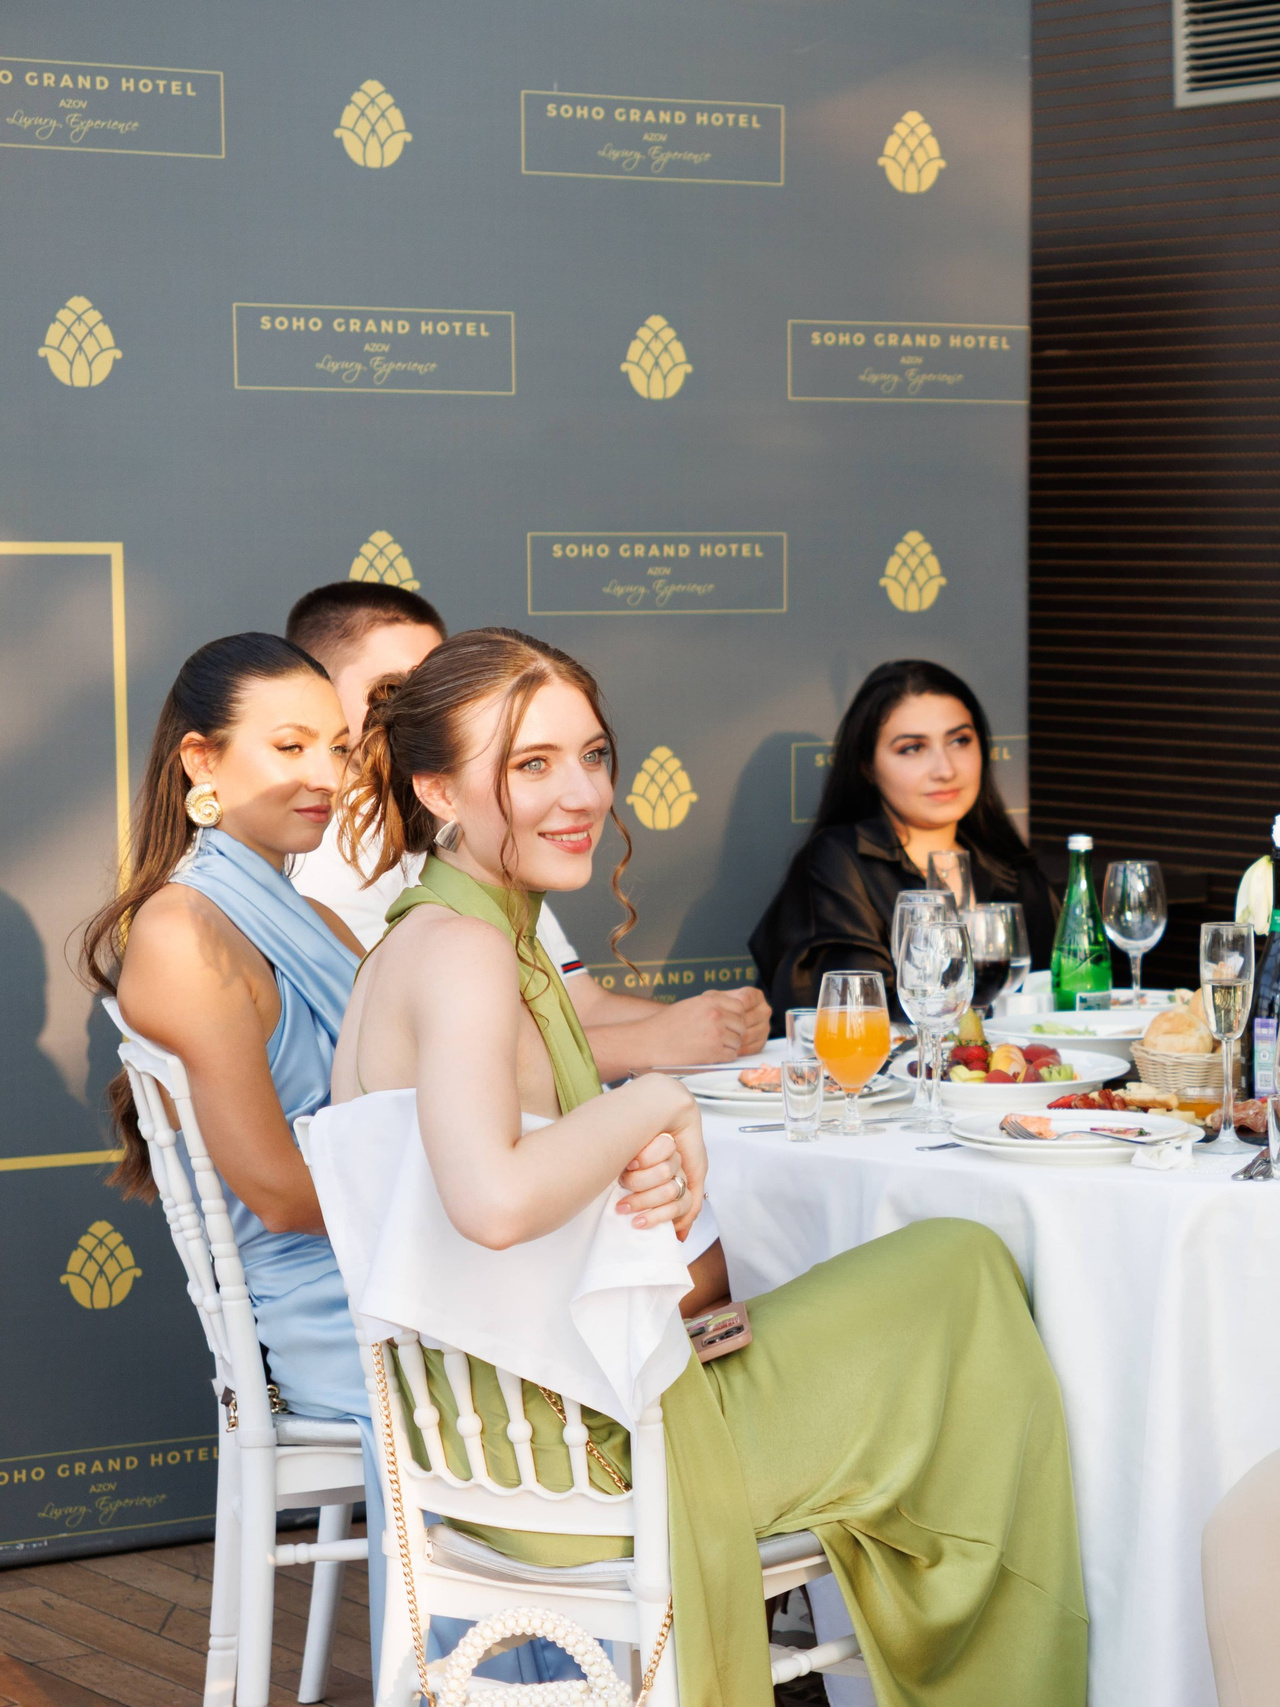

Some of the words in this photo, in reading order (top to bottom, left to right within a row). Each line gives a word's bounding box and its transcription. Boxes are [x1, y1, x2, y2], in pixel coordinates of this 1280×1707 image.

[25, 71, 110, 91] GRAND
[121, 77, 197, 97] HOTEL
[546, 103, 605, 120] SOHO
[614, 107, 687, 125] GRAND
[695, 112, 762, 129] HOTEL
[259, 315, 323, 332] SOHO
[333, 318, 411, 335] GRAND
[420, 320, 490, 337] HOTEL
[811, 331, 866, 346] SOHO
[873, 333, 942, 348] GRAND
[949, 335, 1011, 350] HOTEL
[552, 543, 610, 558] SOHO
[619, 543, 691, 558] GRAND
[699, 543, 764, 558] HOTEL
[624, 971, 695, 989] GRAND
[704, 966, 755, 983] HOTE
[0, 1466, 46, 1486] OHO
[56, 1456, 139, 1478] GRAND
[149, 1445, 219, 1467] HOTEL
